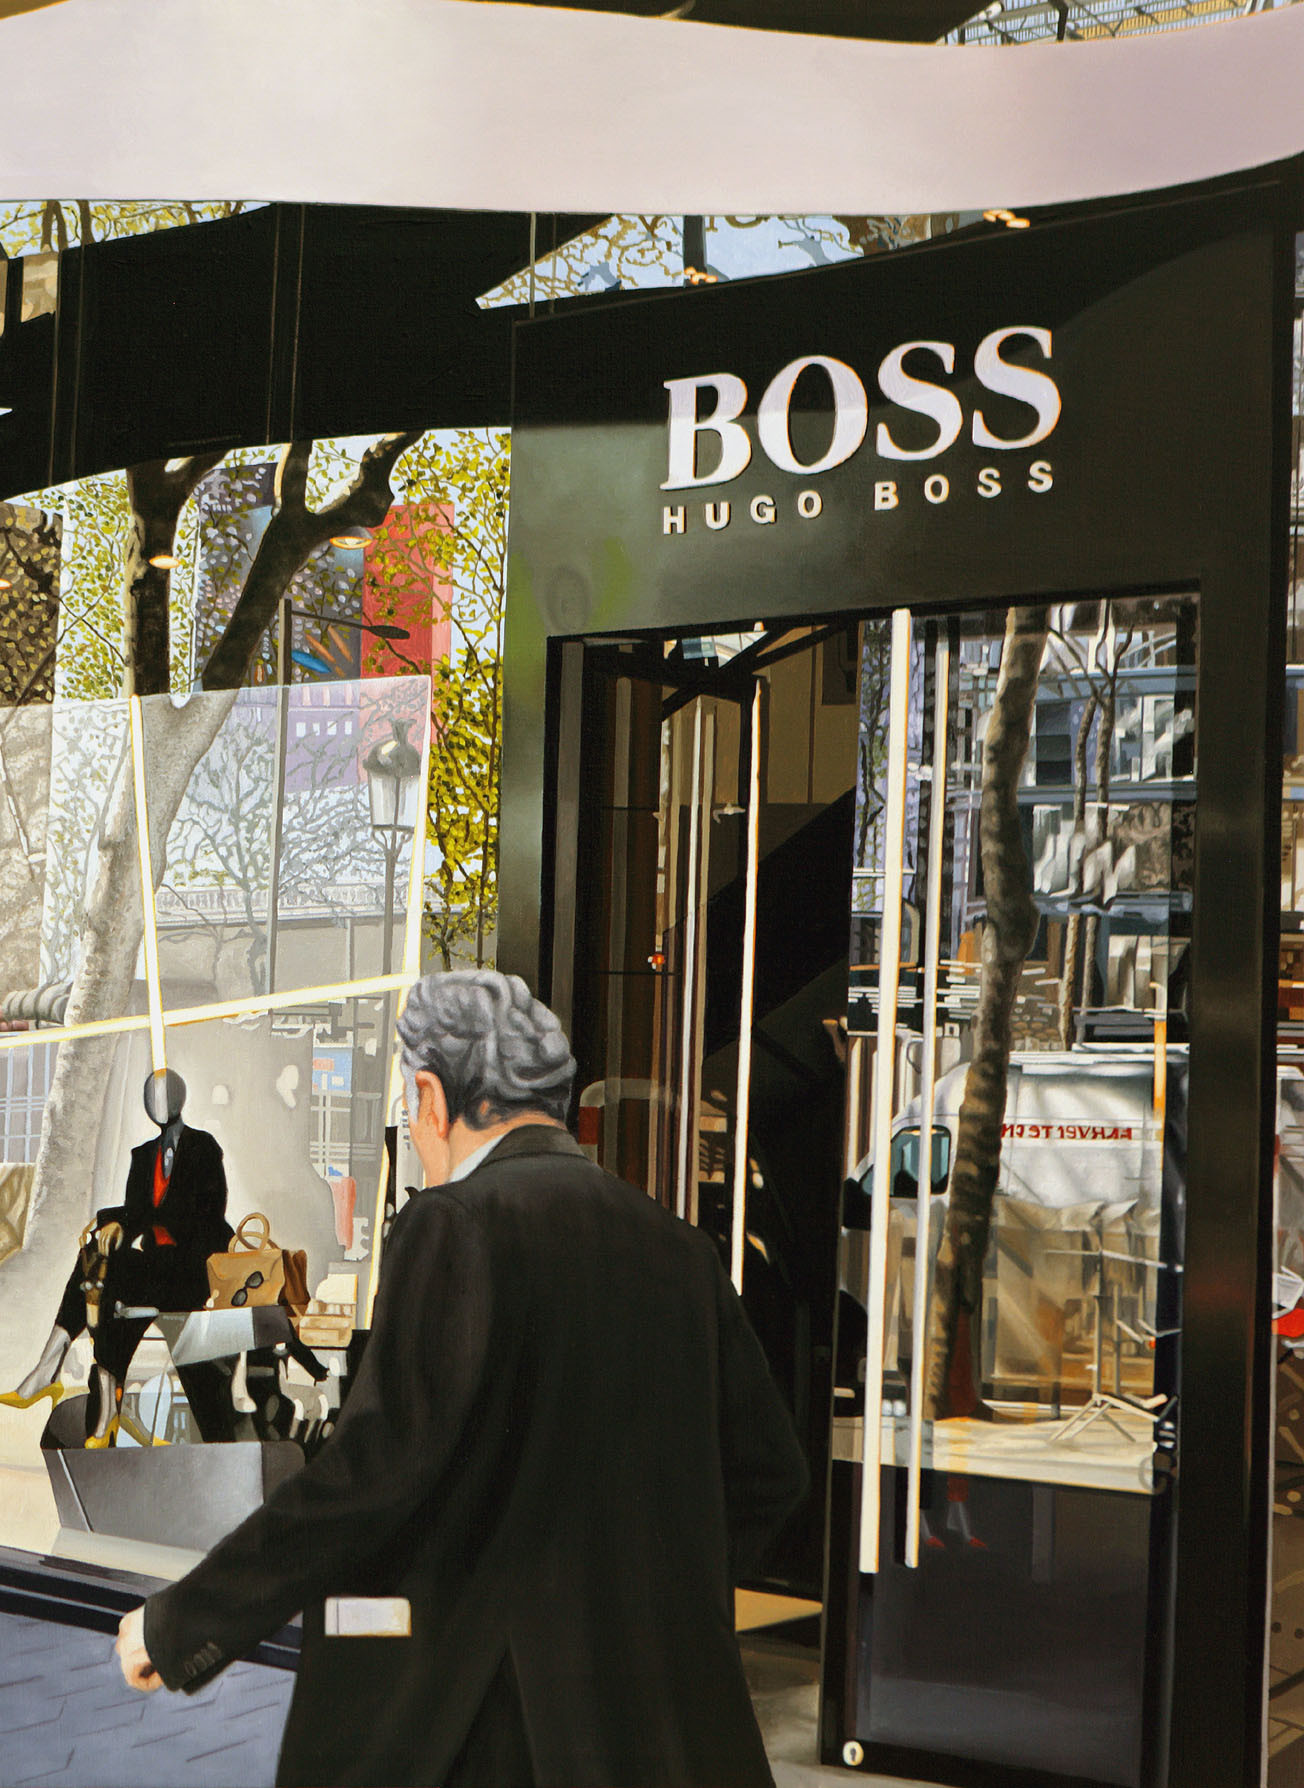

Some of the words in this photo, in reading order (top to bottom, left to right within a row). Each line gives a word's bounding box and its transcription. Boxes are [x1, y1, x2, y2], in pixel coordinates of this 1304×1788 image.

[660, 325, 1062, 490] BOSS
[663, 490, 823, 534] HUGO
[875, 461, 1054, 510] BOSS
